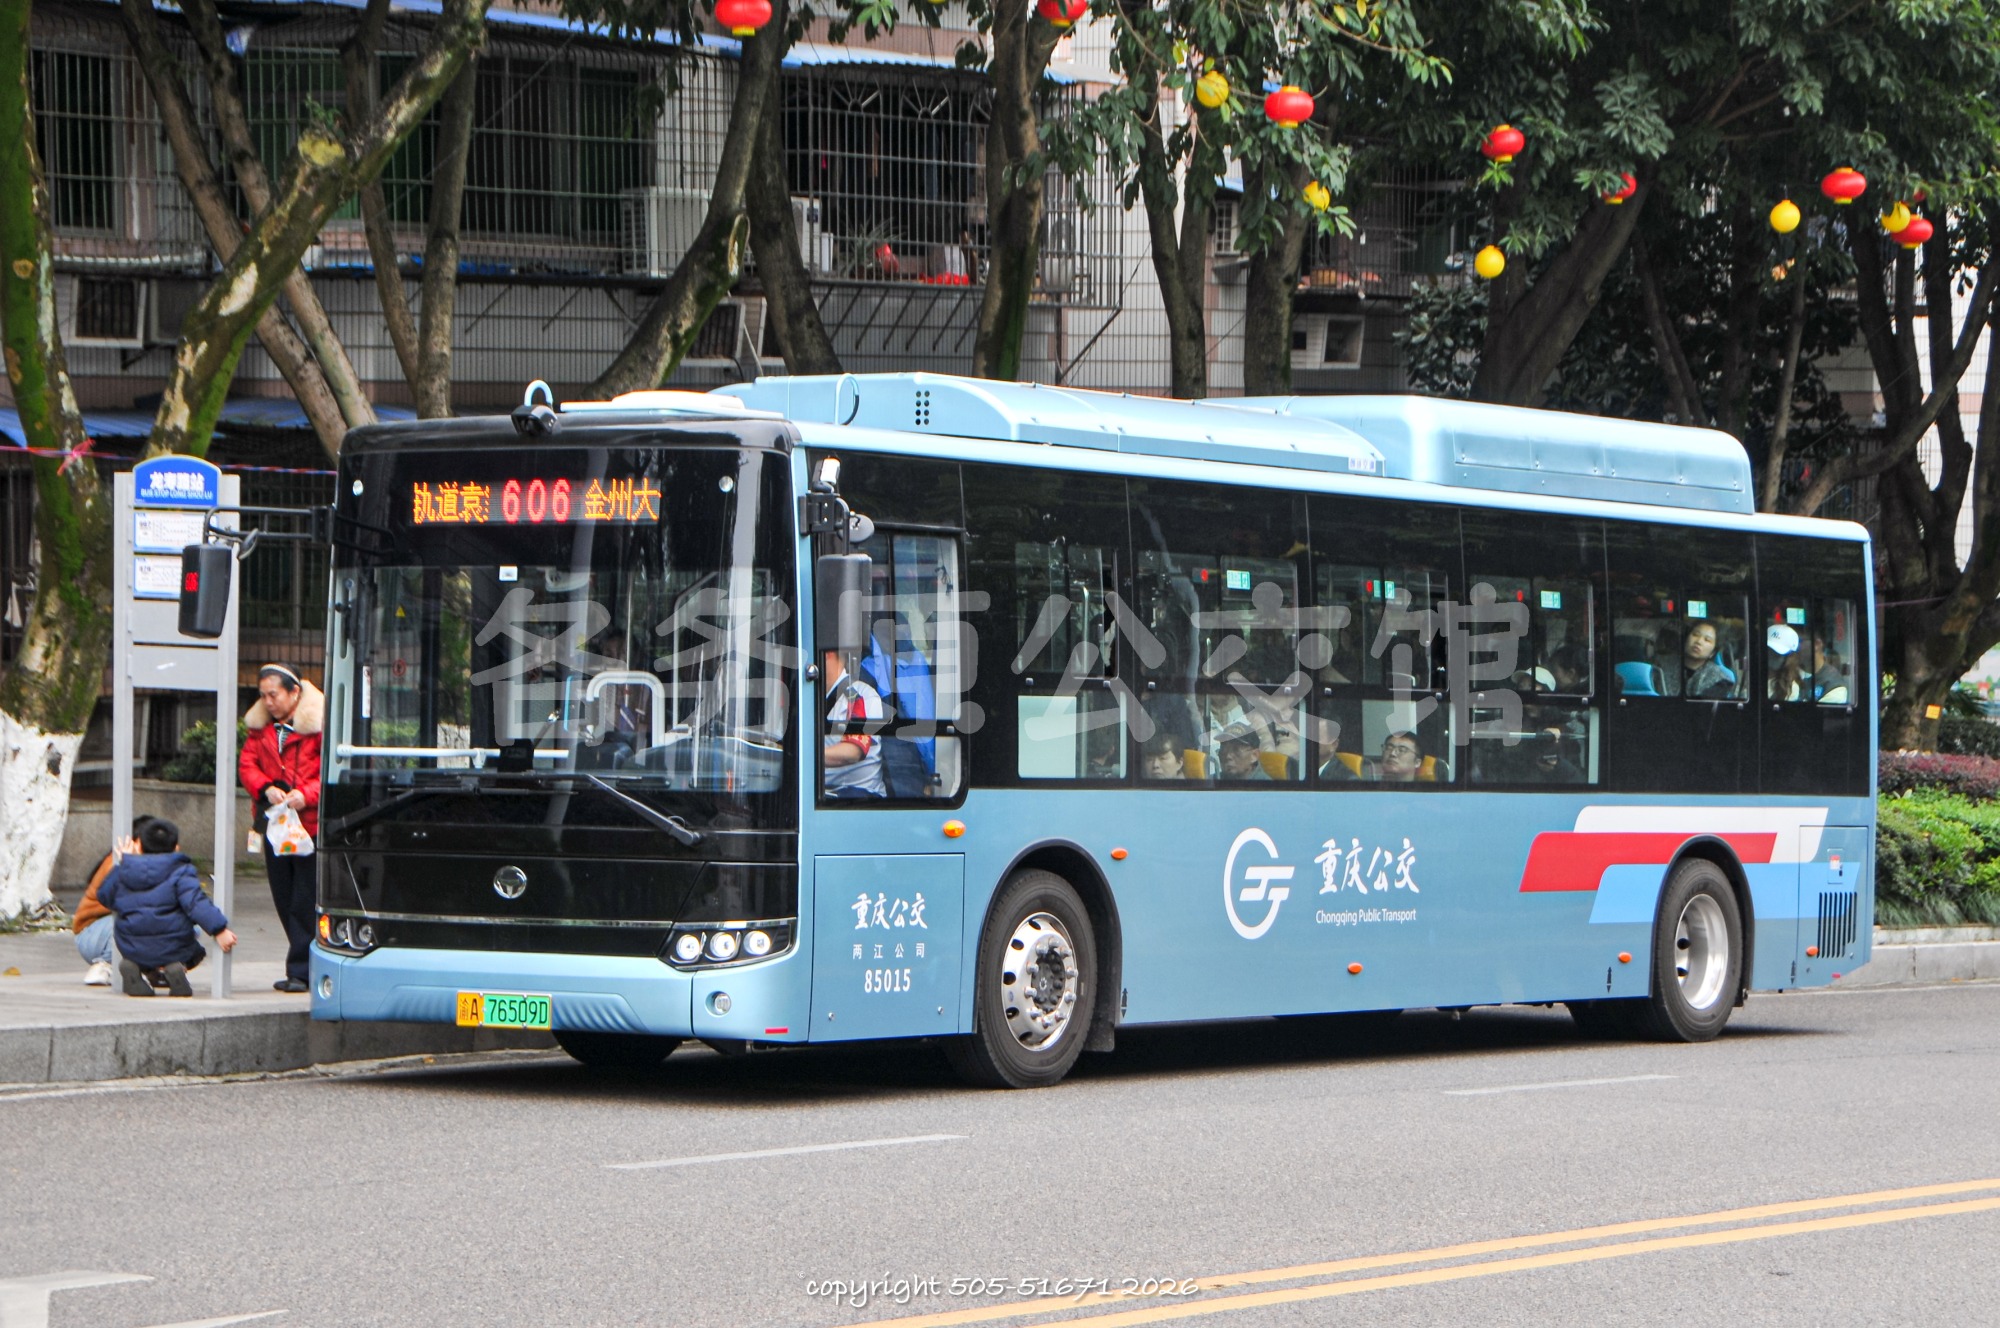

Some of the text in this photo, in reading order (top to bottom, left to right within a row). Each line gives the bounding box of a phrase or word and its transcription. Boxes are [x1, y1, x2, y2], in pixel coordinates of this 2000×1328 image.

[413, 477, 661, 524] 轨道袁 606 金州大
[1313, 838, 1420, 895] 重庆公交
[851, 892, 928, 930] 重庆公交
[1315, 908, 1417, 926] Chongqing Public Transport
[852, 942, 925, 960] 两江公司
[864, 968, 911, 993] 85015
